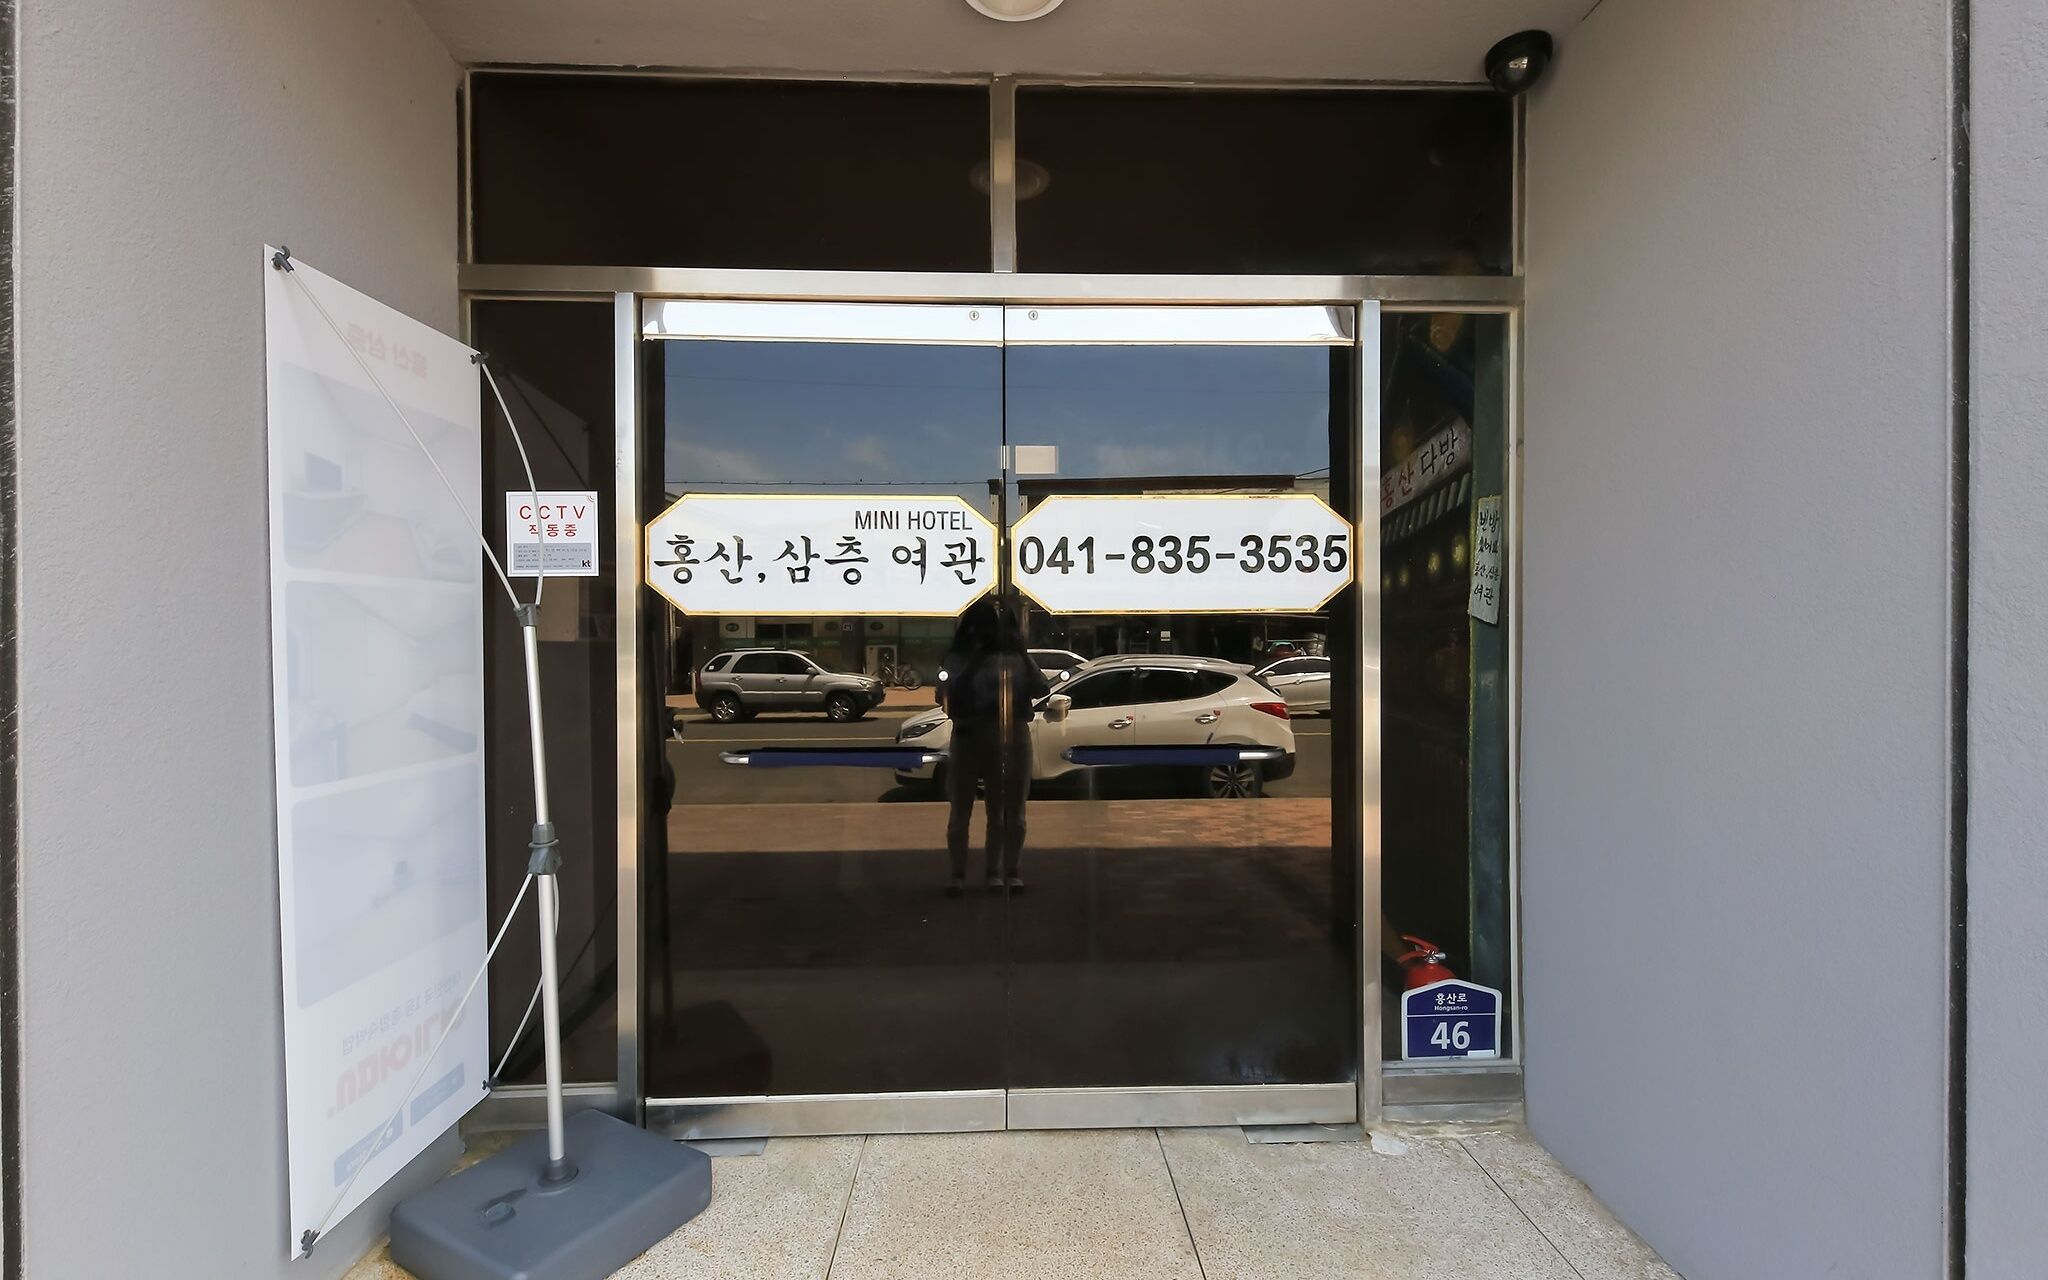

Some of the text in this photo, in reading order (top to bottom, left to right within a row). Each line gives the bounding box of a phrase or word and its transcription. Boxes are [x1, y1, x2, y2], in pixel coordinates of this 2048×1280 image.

[1381, 427, 1458, 508] 홍산 다방
[519, 505, 586, 520] CCTV
[855, 509, 973, 531] MINI HOTEL
[1479, 510, 1499, 533] 빈방
[892, 536, 985, 586] 여관
[1019, 533, 1348, 576] 041-835-3535
[1473, 583, 1494, 606] 여관
[1435, 993, 1467, 1005] 홍산로
[1430, 1021, 1471, 1050] 46
